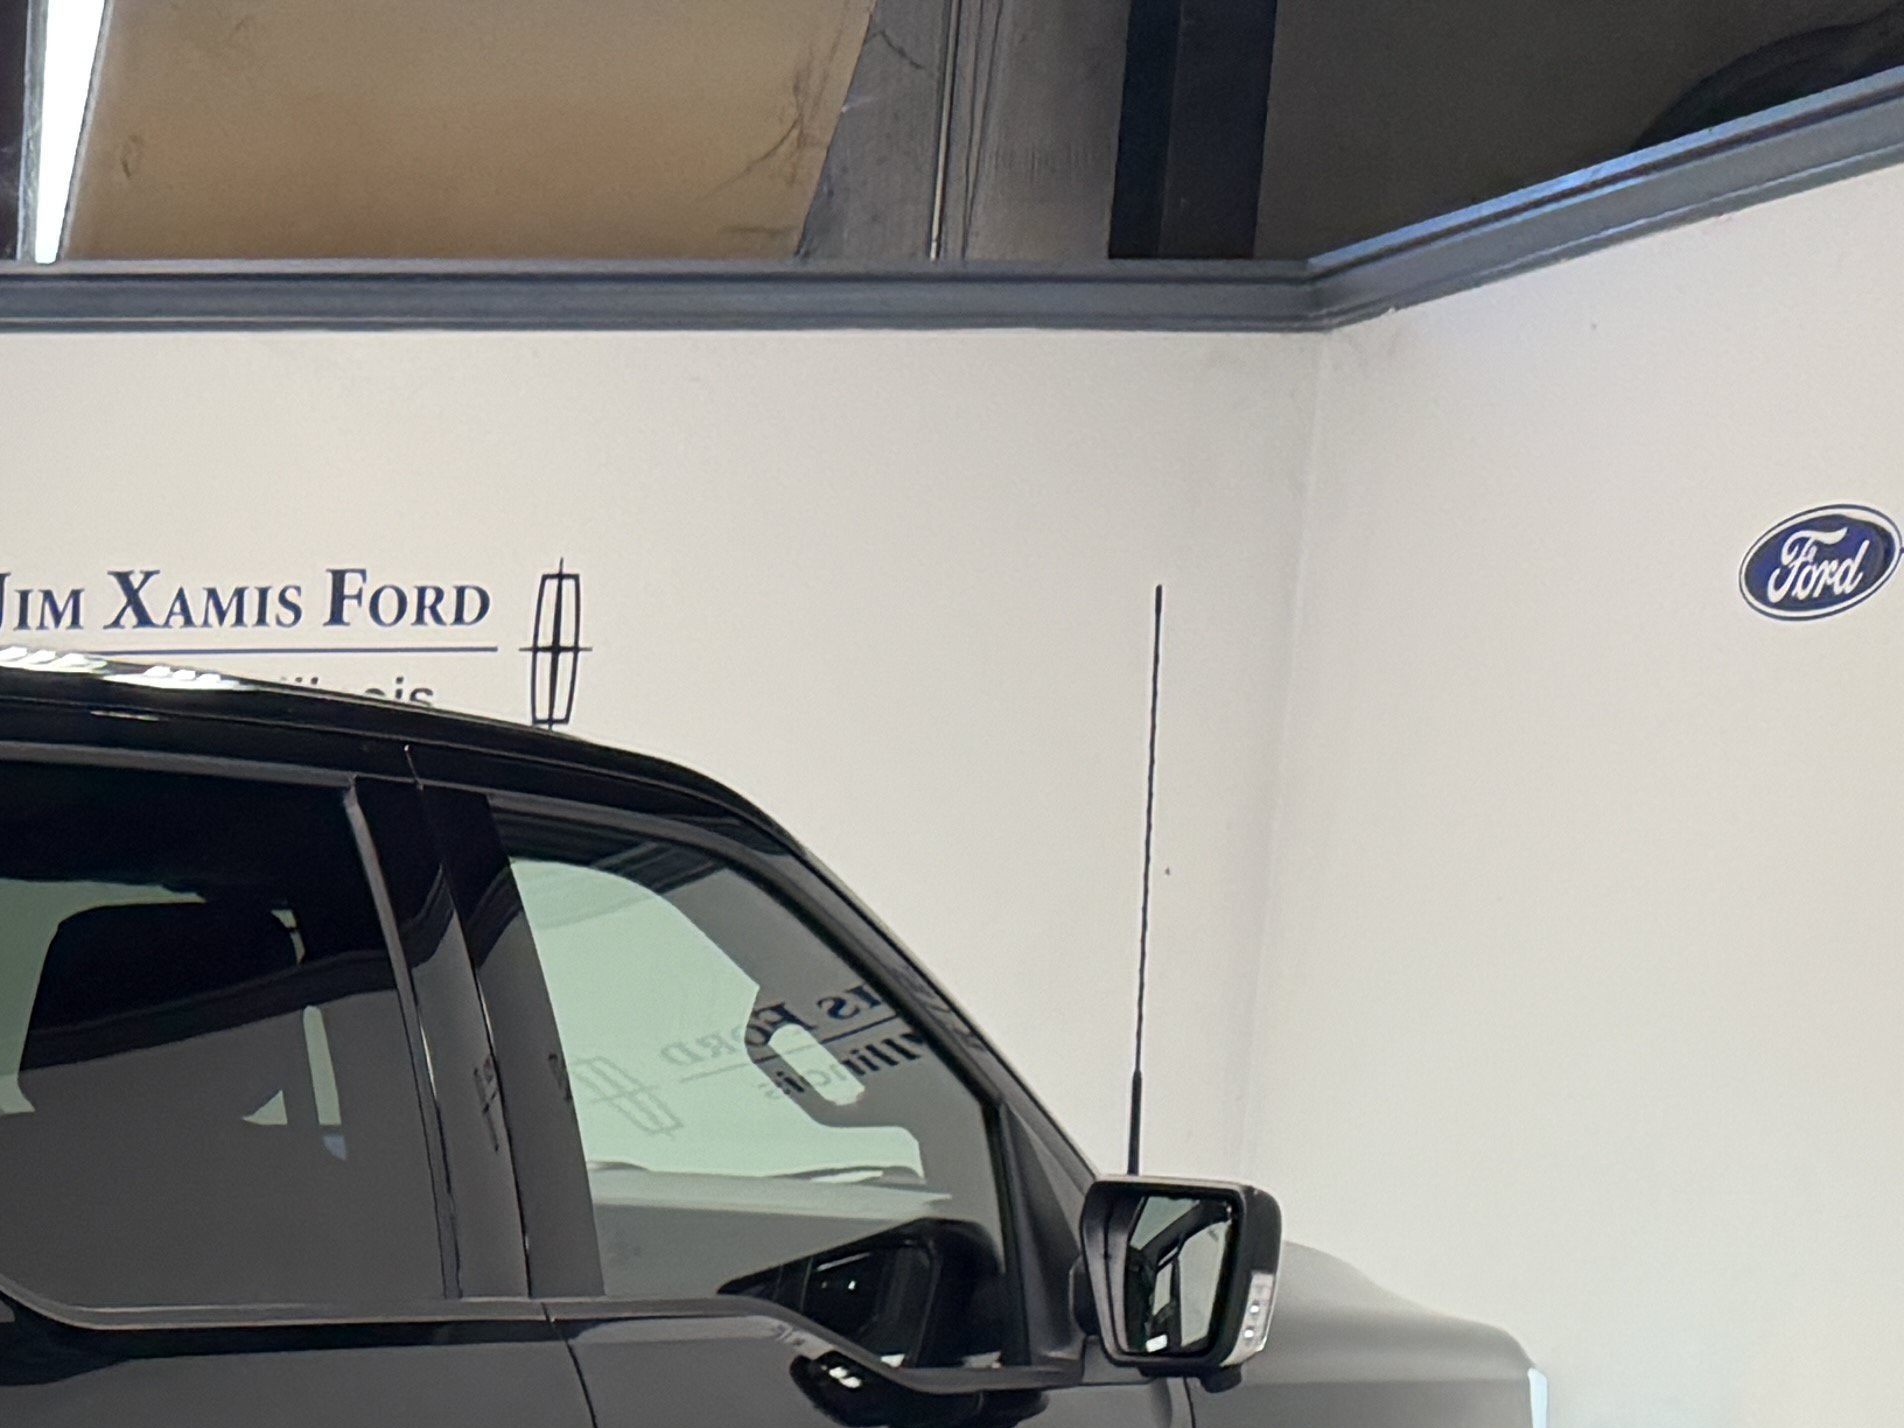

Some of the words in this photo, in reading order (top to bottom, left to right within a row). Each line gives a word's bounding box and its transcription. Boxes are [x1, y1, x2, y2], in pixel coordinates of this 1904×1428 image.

[104, 570, 302, 629] XAMIS
[324, 568, 490, 627] FORD
[1767, 527, 1870, 603] Ford
